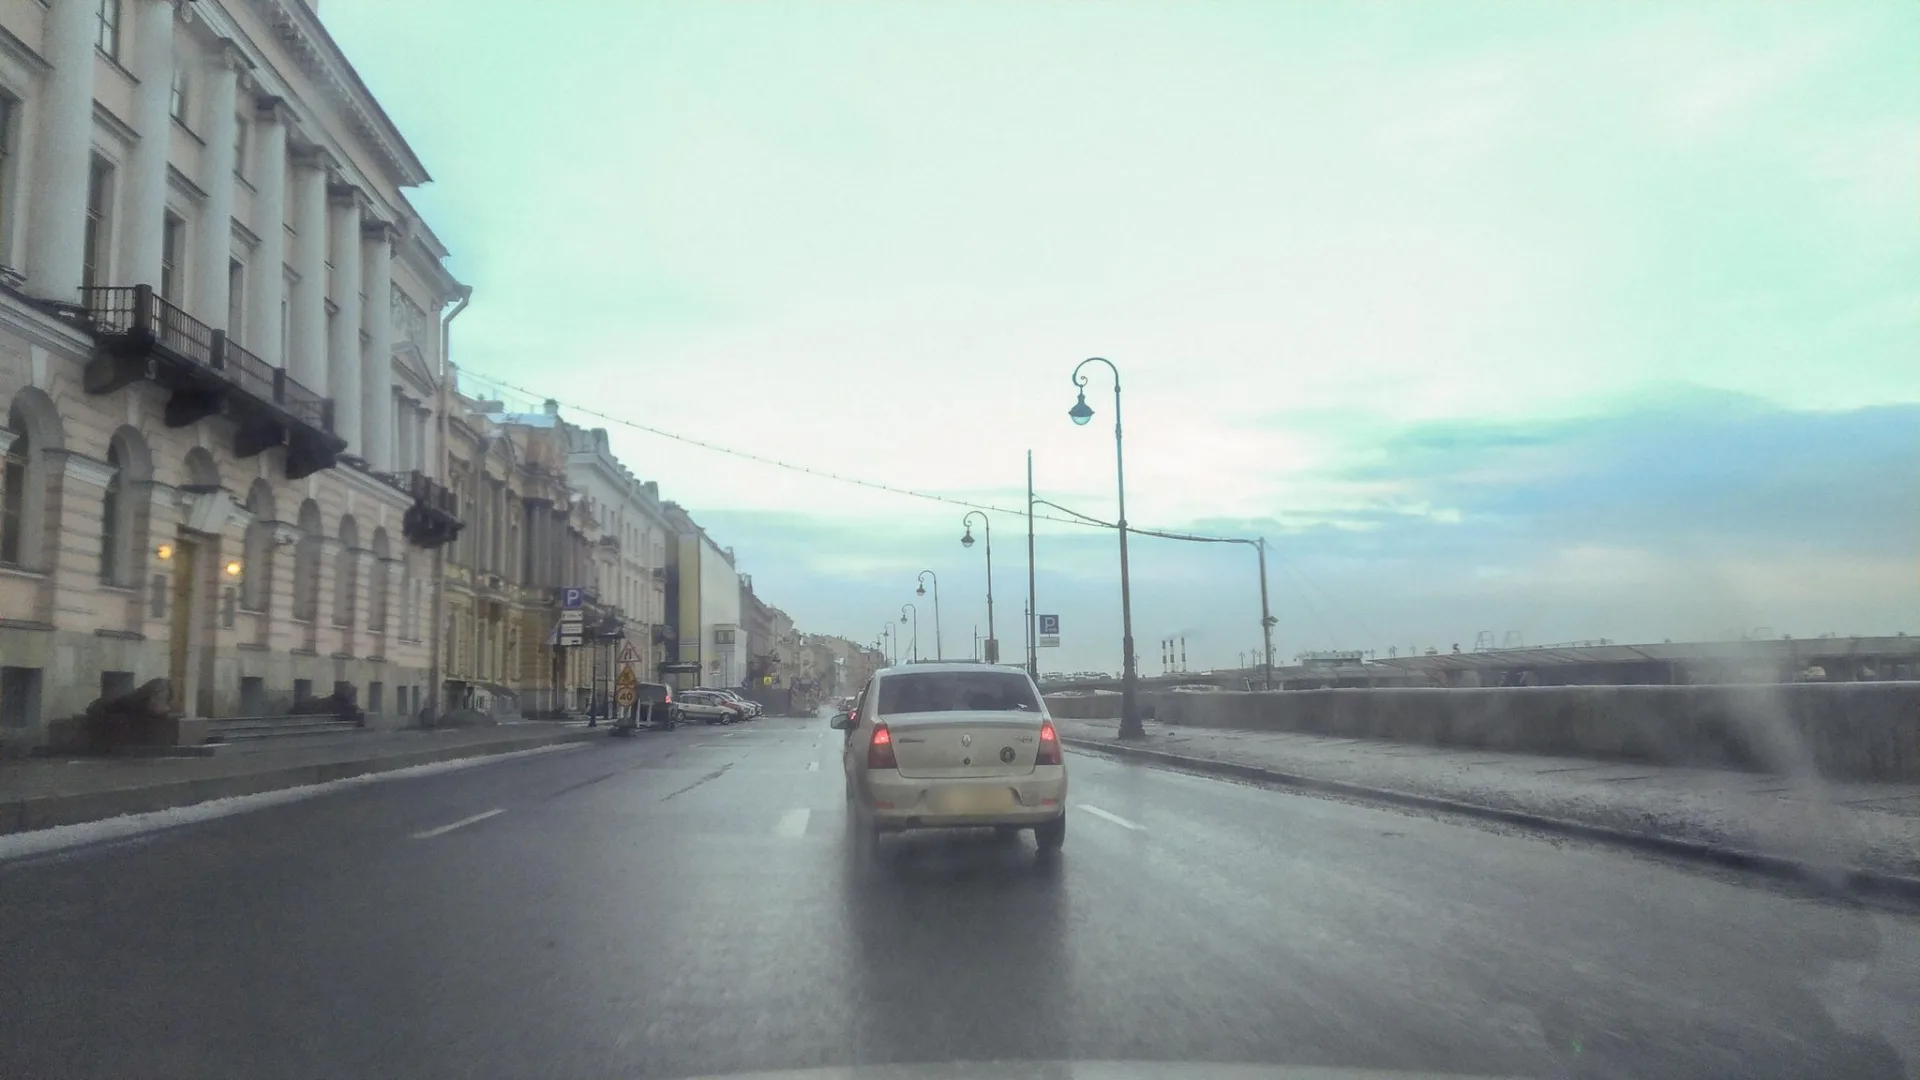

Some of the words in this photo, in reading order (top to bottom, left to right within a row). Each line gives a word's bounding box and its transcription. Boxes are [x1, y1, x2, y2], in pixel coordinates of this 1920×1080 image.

[567, 589, 579, 606] P
[1044, 617, 1056, 632] P
[619, 692, 633, 701] 40
